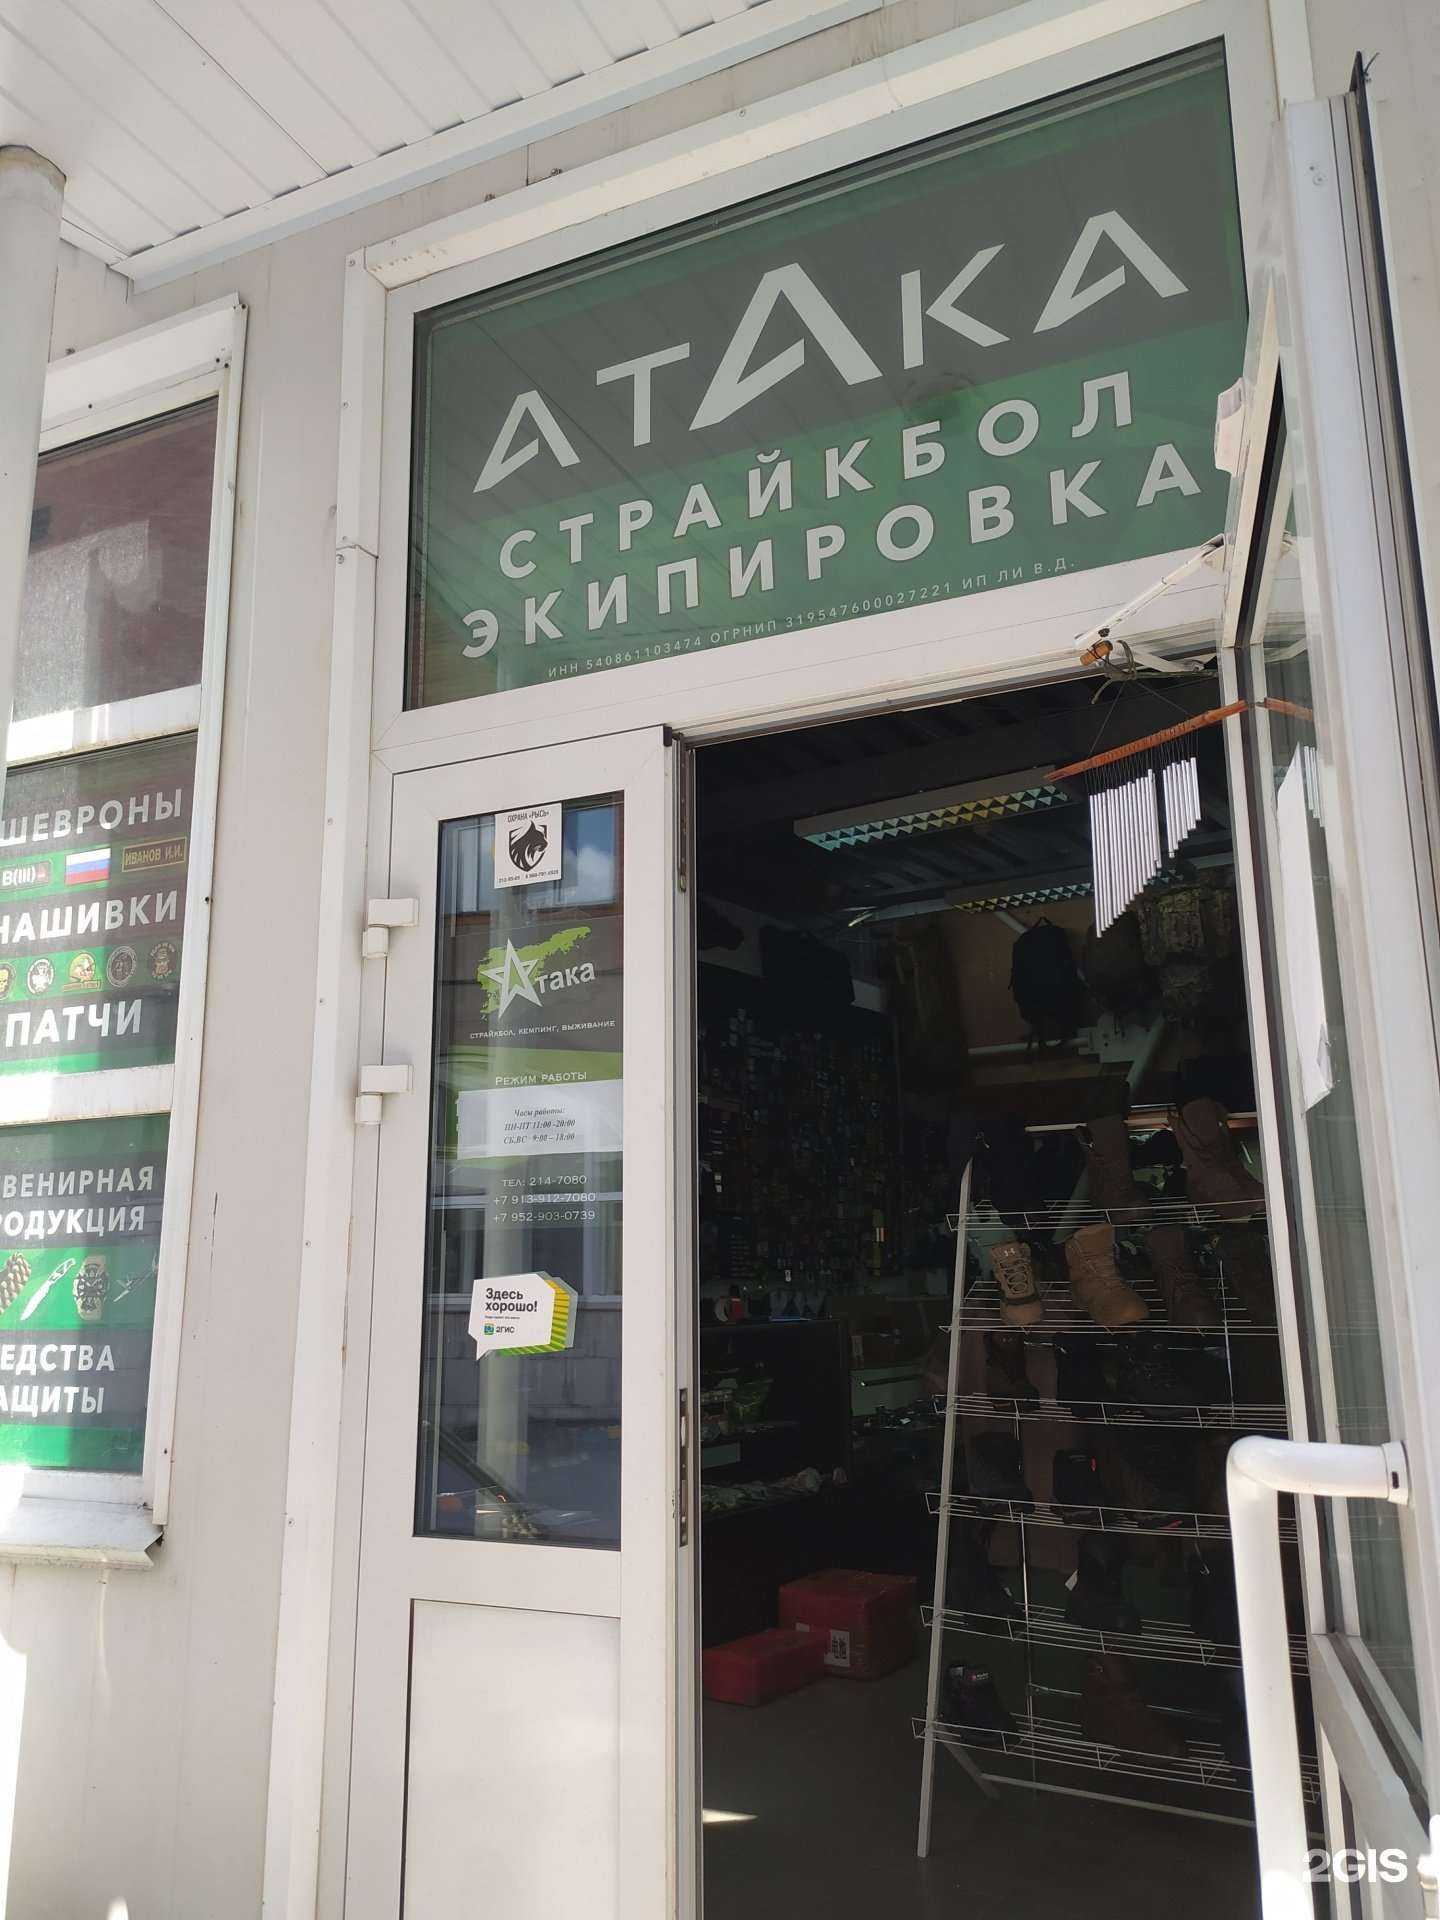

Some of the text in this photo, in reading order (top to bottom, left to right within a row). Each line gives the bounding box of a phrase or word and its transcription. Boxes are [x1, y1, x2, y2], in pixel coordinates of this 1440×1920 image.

[473, 210, 1189, 494] АТАКА
[499, 371, 1133, 580] СТРАЙКБОЛ
[462, 443, 1202, 659] ЭКИПИРОВКА
[548, 557, 1075, 677] ИНН 540861103474 ОГРНИП 319547600027221 ИП ЛИ В.Д.
[0, 789, 182, 846] ШЕВРОНЫ
[125, 848, 160, 865] ИВАНОВ
[5, 999, 142, 1047] ПАТЧИ
[470, 1020, 616, 1039] СТРАЙКБОЛ, КЕМПИНГ, ВЫЖИВАНИЕ
[495, 1072, 587, 1086] РЕЖИМ РАБОТЫ
[529, 1175, 587, 1186] 214-7080
[494, 1196, 508, 1205] +7
[0, 1205, 144, 1240] ОДУКЦИЯ
[494, 1210, 596, 1222] +7 952-903-0739
[486, 1288, 523, 1301] Здесь
[485, 1300, 538, 1314] хорошо!
